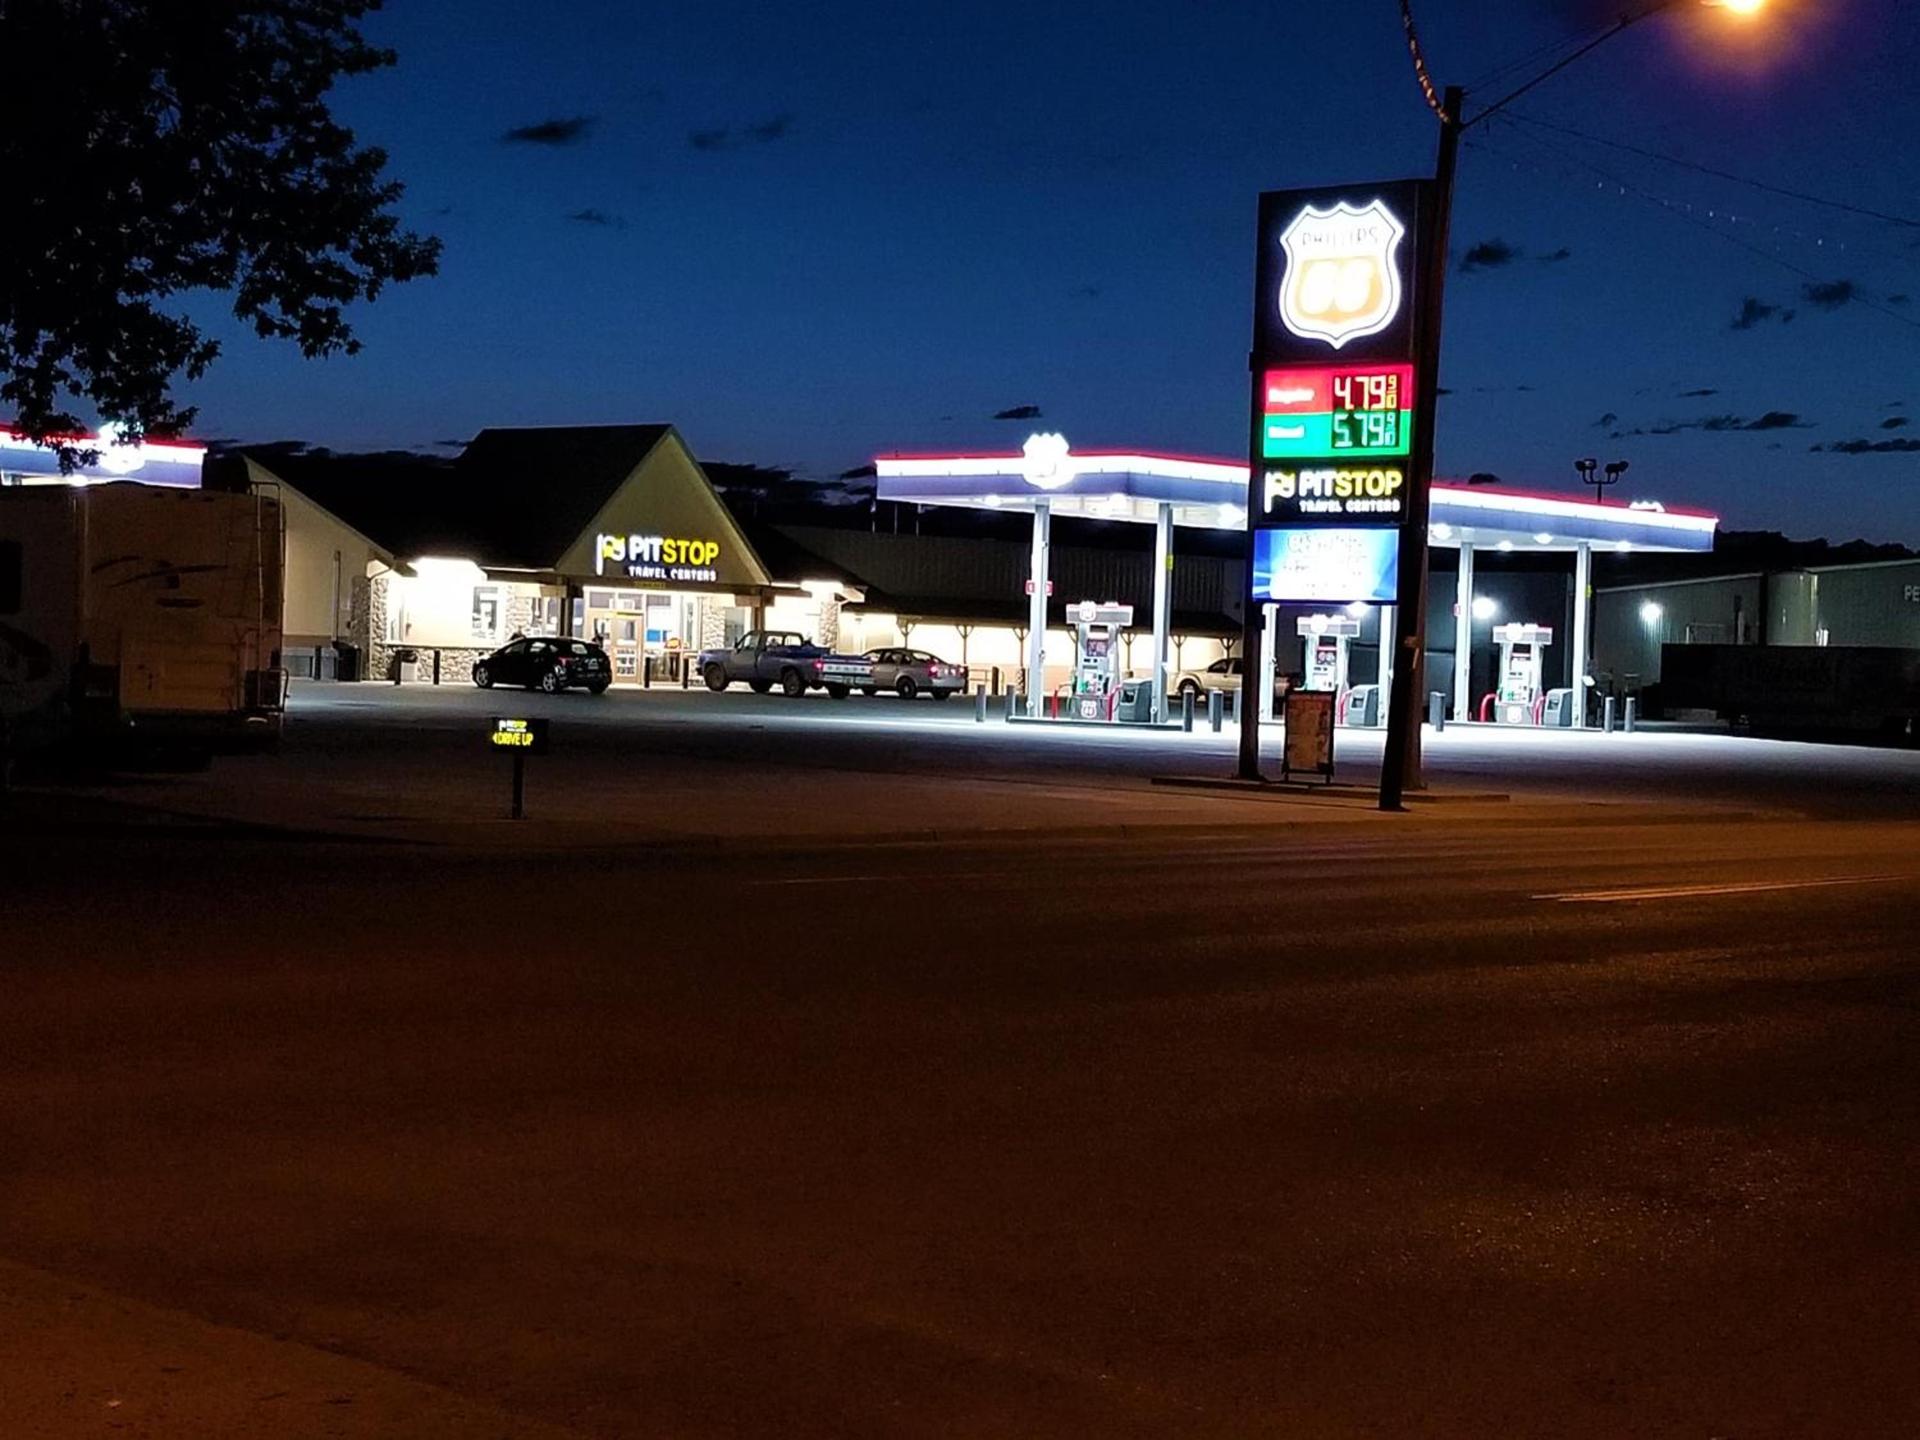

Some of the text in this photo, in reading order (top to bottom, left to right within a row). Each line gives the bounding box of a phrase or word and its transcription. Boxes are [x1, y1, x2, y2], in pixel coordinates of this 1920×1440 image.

[628, 565, 717, 582] TRAVEL CENTERS
[497, 731, 534, 747] DRIVE UP
